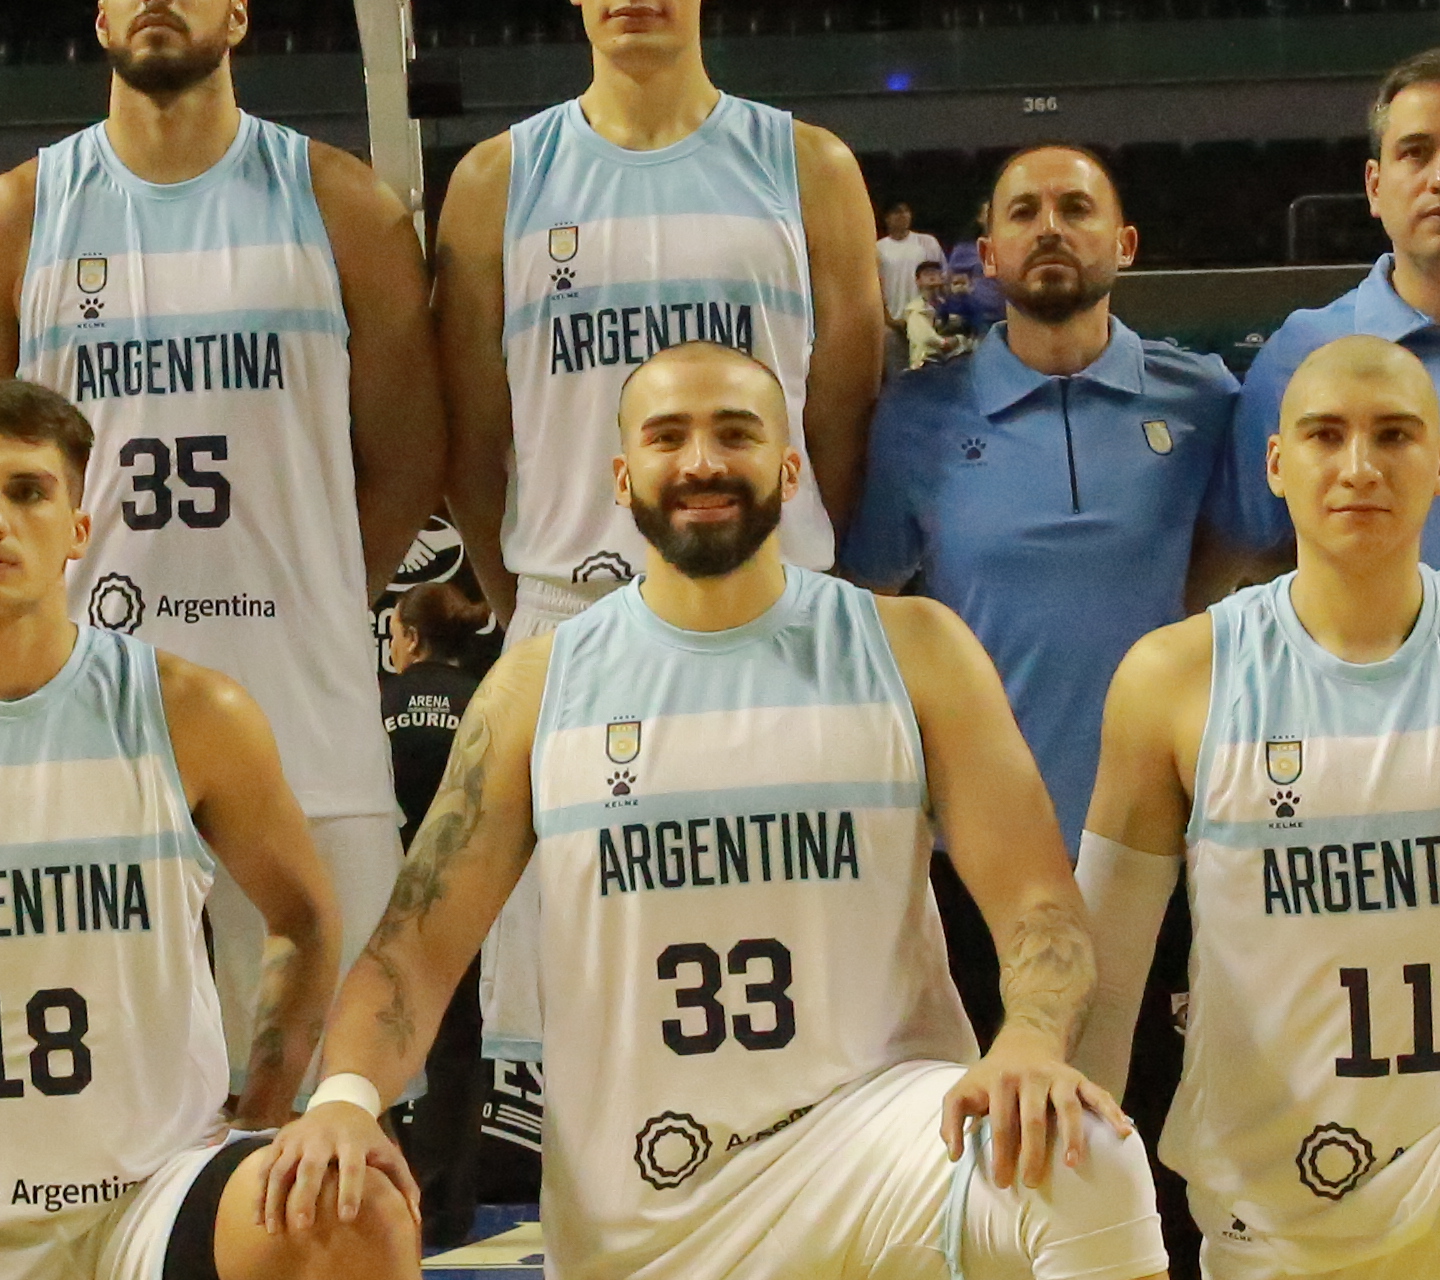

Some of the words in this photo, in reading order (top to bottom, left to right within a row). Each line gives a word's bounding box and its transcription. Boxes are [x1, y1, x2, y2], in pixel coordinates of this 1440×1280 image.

[551, 303, 752, 374] ARGENTINA
[76, 333, 283, 403] ARGENTINA
[118, 435, 231, 532] 35
[156, 593, 276, 623] Argentina
[408, 696, 450, 708] ARENA
[384, 712, 460, 733] EGURID
[604, 799, 639, 809] KELME
[1269, 821, 1301, 830] KELME
[600, 811, 860, 896] ARGENTINA
[656, 938, 796, 1057] 33
[11, 1174, 144, 1213] Argenti
